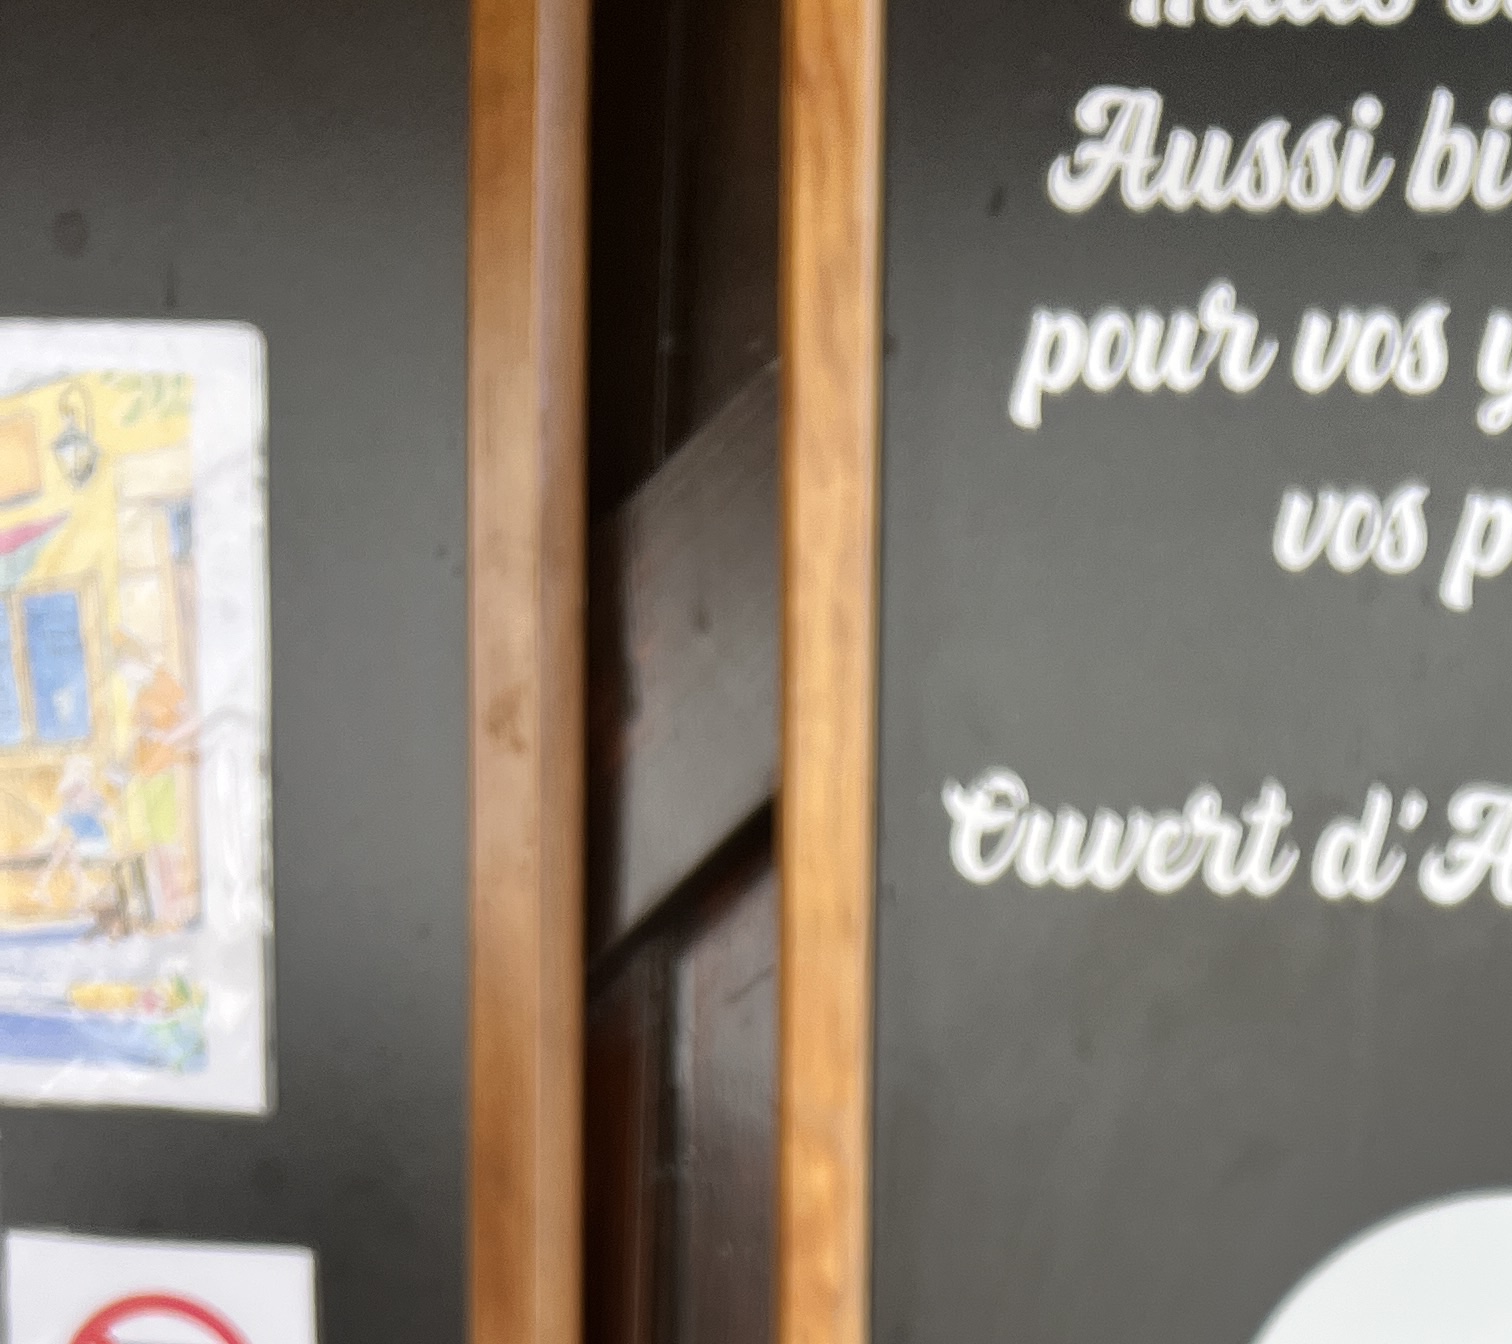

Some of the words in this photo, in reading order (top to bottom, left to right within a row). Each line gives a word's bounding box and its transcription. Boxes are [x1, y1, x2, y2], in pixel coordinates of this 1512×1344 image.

[1047, 86, 1395, 211] Aussi
[1008, 281, 1280, 430] pour
[1292, 302, 1451, 395] vos
[1272, 483, 1429, 575] vos
[942, 769, 1301, 898] Ouvert
